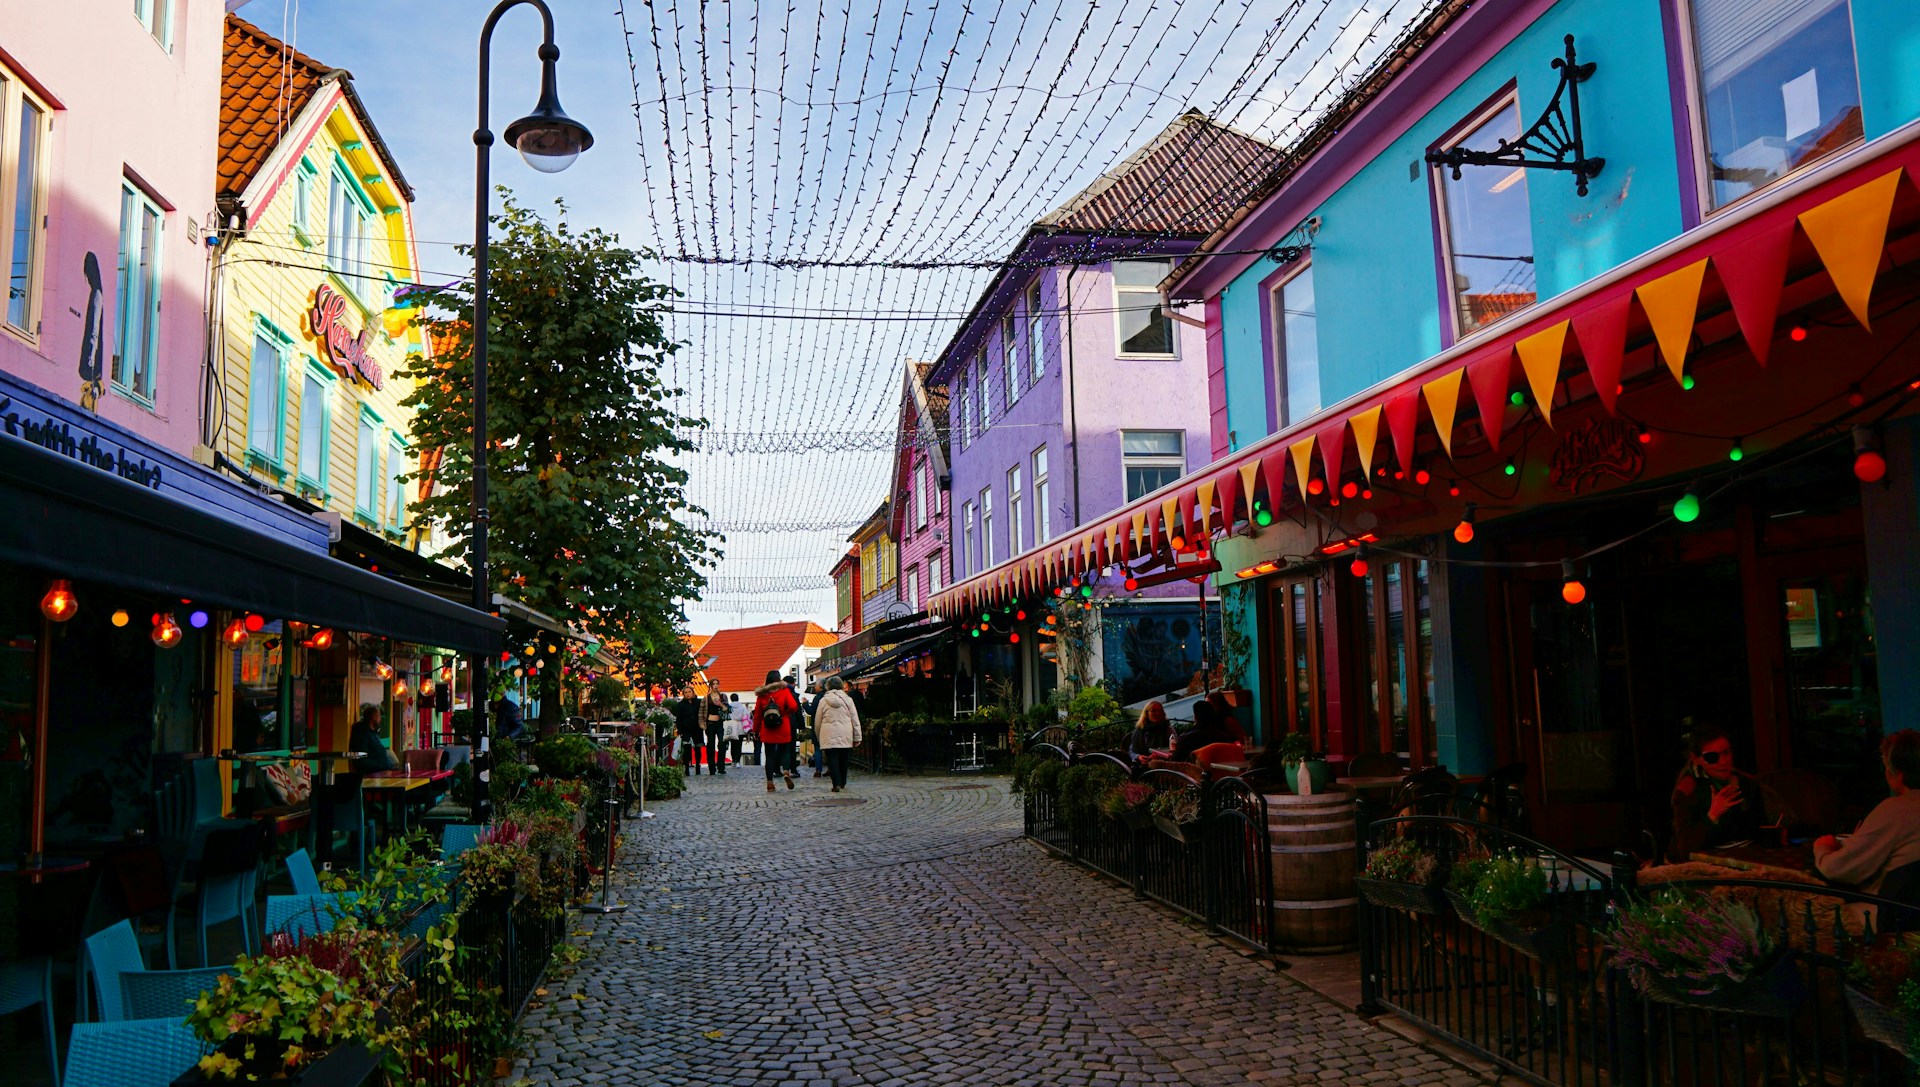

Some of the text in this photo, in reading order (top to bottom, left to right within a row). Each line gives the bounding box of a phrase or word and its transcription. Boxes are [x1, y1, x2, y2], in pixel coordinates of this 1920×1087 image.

[23, 418, 76, 458] with
[80, 435, 115, 471] the
[118, 448, 162, 490] hair?
